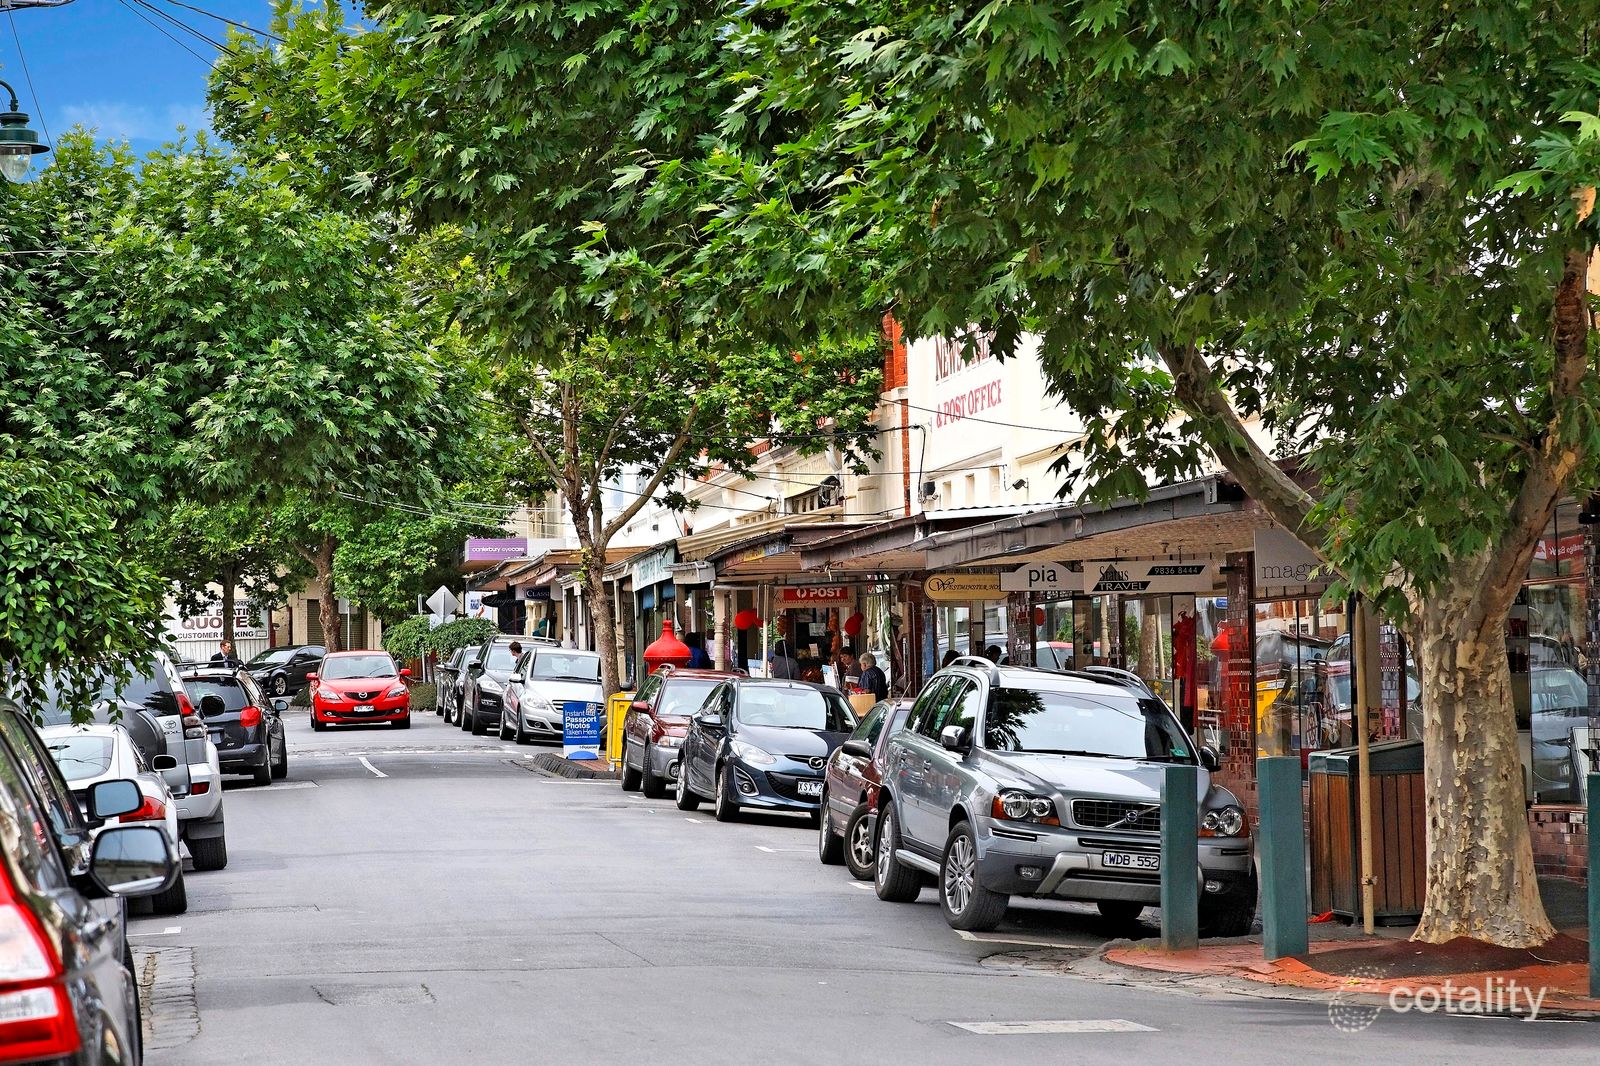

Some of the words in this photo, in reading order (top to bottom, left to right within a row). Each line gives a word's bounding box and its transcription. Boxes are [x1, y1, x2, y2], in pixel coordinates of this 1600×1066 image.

[936, 404, 943, 428] &
[943, 393, 967, 426] POST
[1177, 566, 1198, 574] 8444
[1029, 565, 1058, 587] pia
[1099, 582, 1145, 591] TRAVEL
[809, 587, 842, 597] POST
[177, 631, 219, 639] CUSTOMER
[220, 630, 254, 638] PKING
